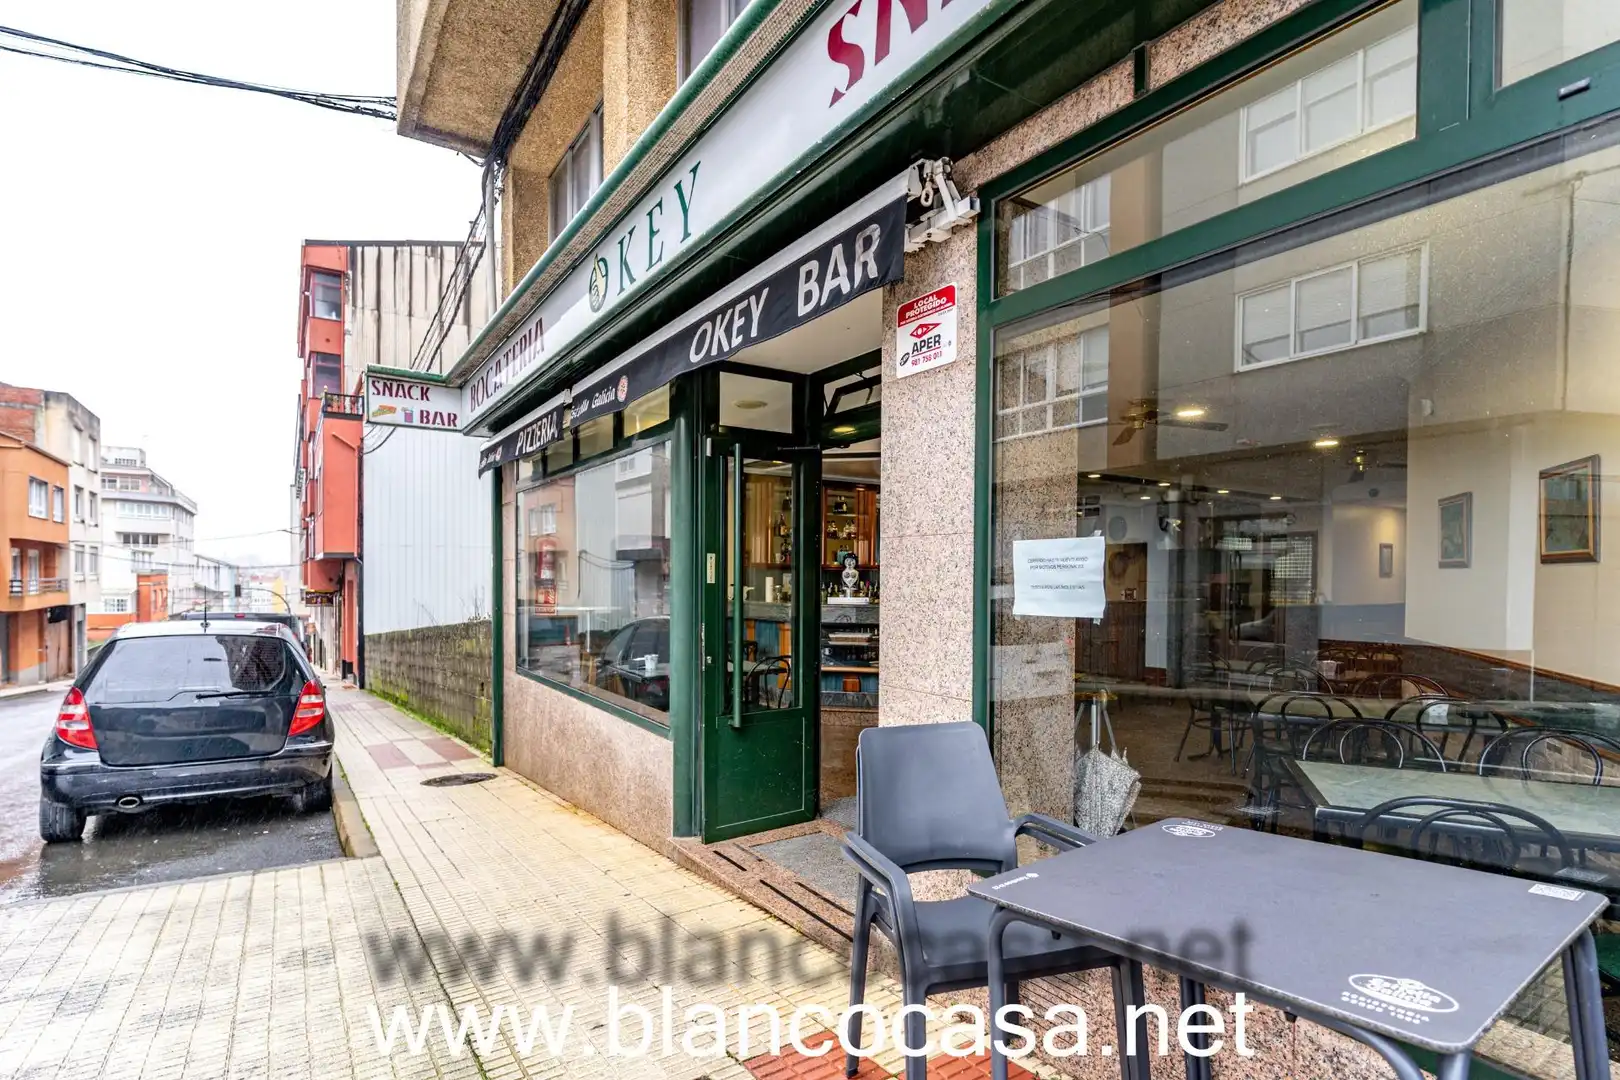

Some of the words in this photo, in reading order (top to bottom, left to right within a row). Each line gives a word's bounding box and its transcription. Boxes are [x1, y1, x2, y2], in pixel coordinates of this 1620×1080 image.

[689, 287, 769, 363] OKEY
[798, 223, 881, 317] BAR
[914, 294, 937, 309] LOCAL
[905, 297, 947, 318] PROTEGIDO
[911, 334, 942, 355] APER
[471, 317, 544, 412] BOCATERIA
[371, 380, 431, 402] SNACK
[420, 409, 458, 428] BAR
[515, 411, 558, 457] PIZZERIA
